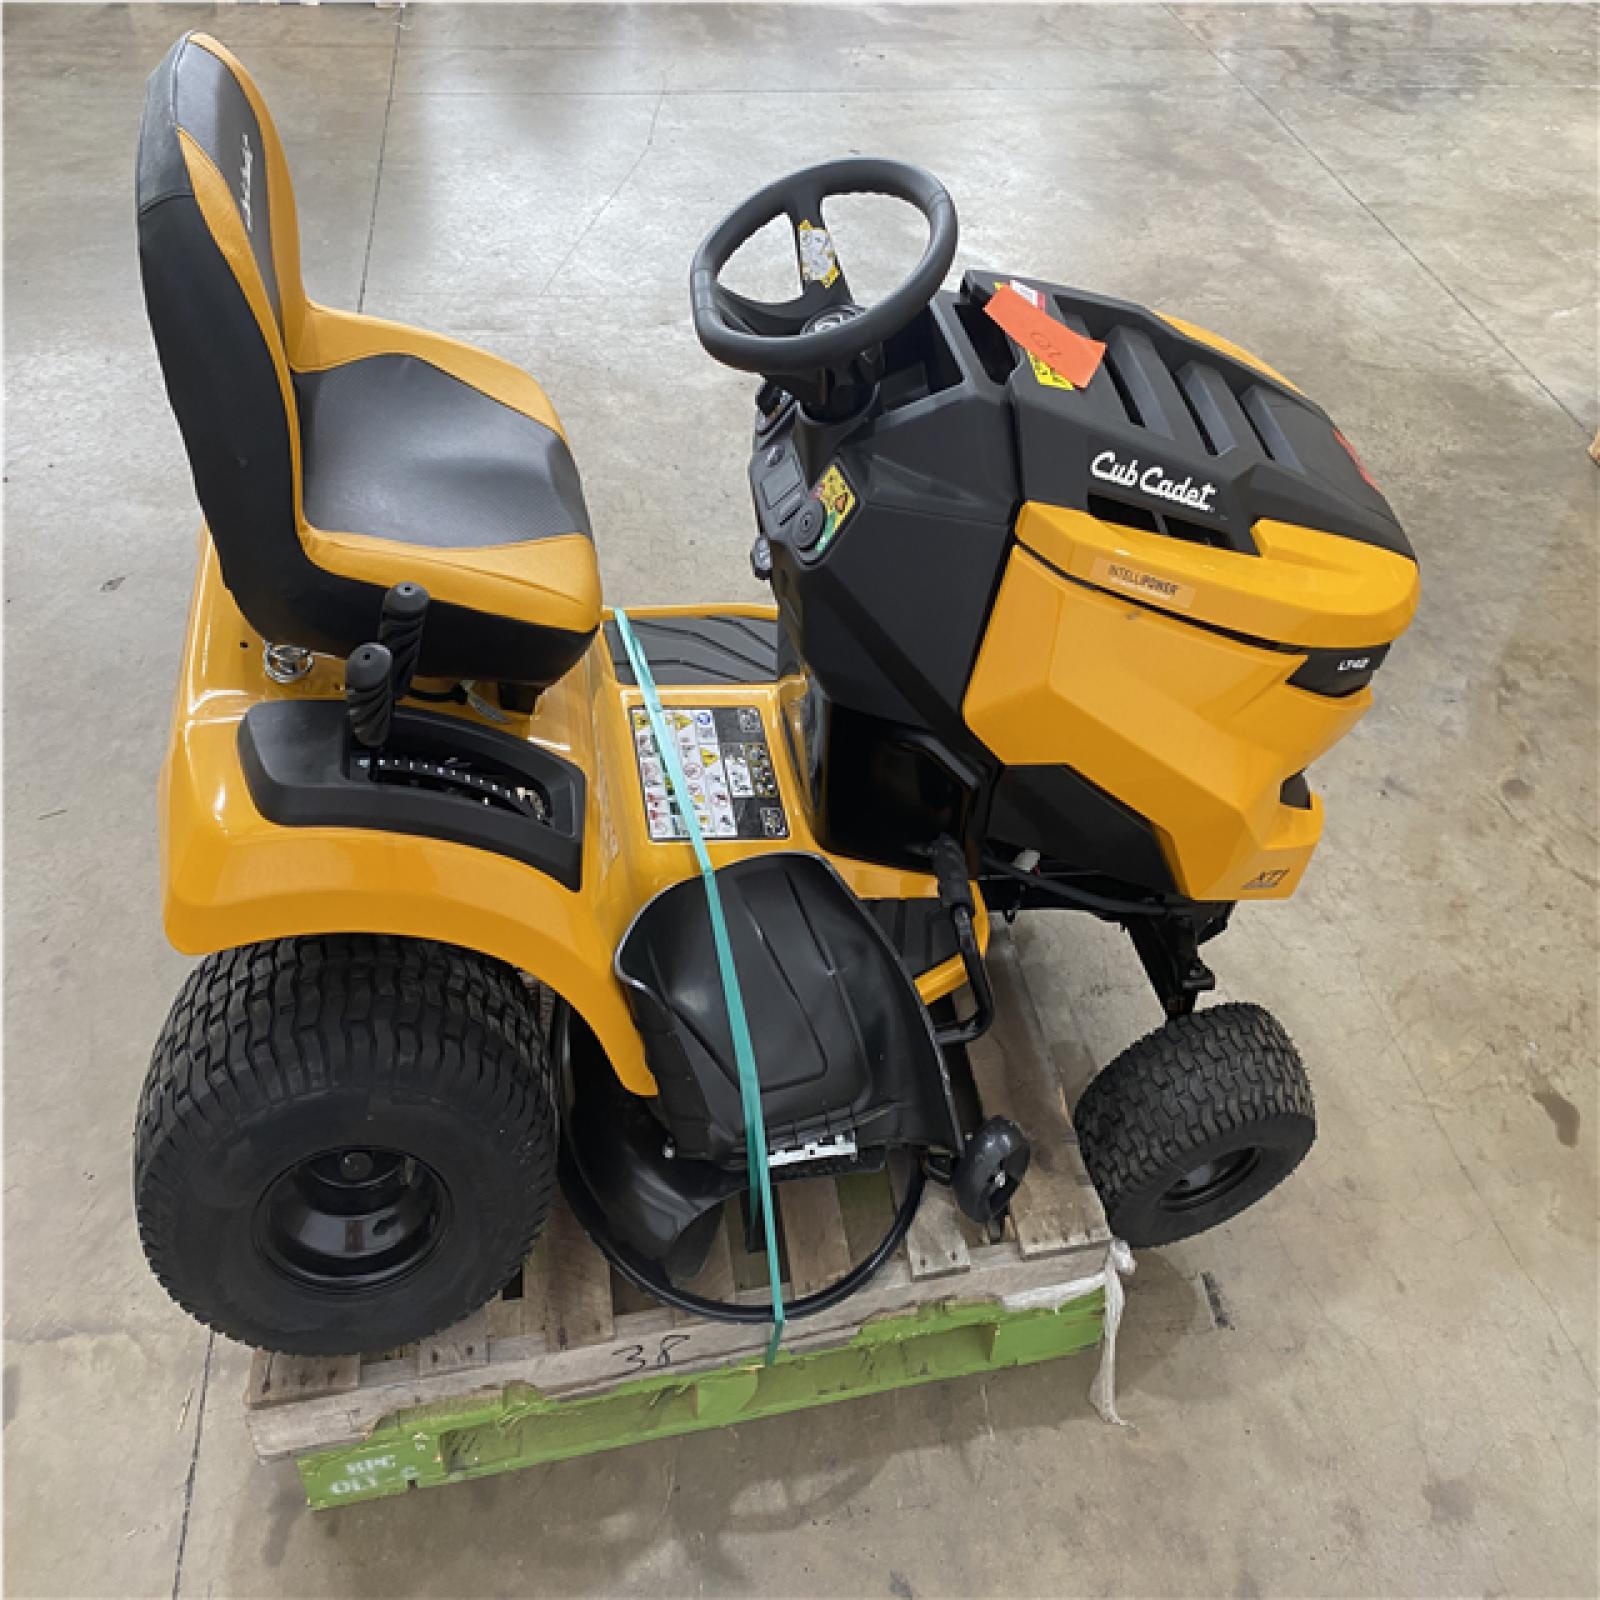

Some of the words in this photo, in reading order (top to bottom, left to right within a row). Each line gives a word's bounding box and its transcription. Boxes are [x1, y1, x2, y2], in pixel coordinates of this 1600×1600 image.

[1090, 450, 1138, 486] Cub
[1139, 466, 1216, 511] Cadet
[612, 1334, 691, 1377] 38
